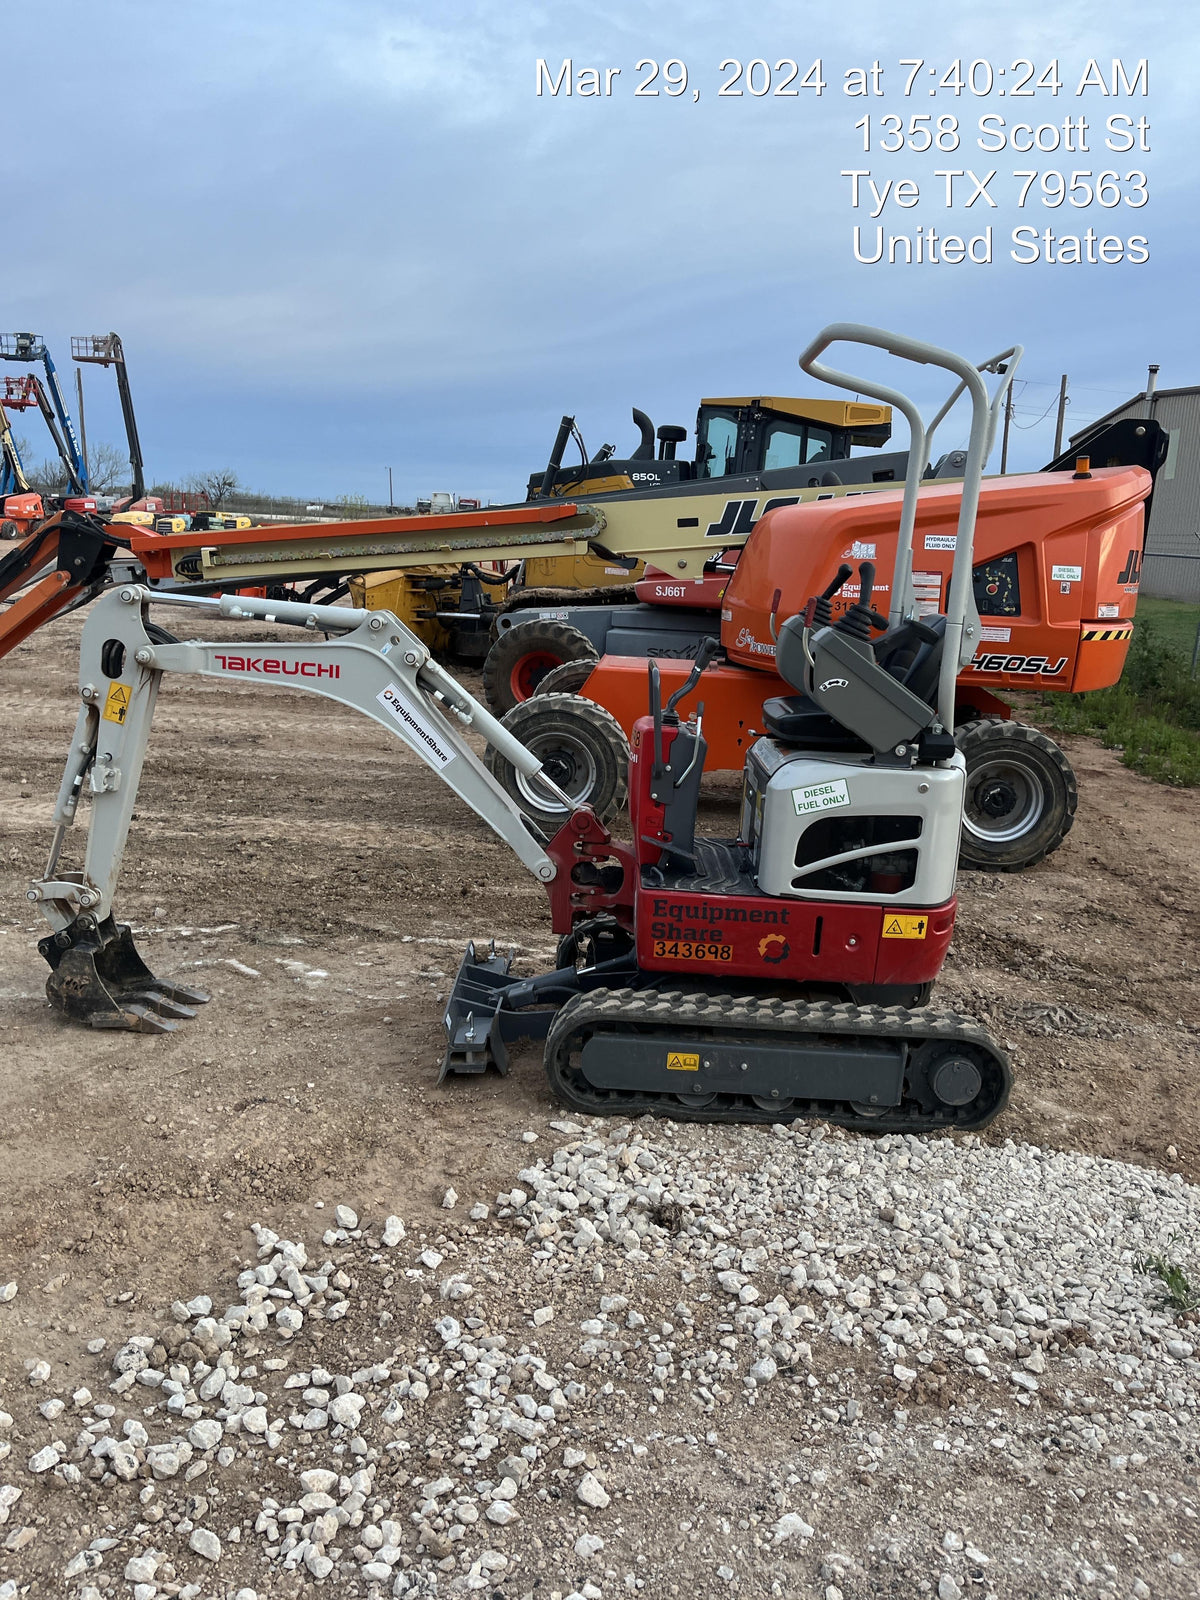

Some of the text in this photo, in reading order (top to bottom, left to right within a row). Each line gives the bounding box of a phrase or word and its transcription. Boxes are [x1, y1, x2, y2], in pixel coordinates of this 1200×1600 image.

[632, 473, 661, 481] 850L
[655, 585, 687, 598] SJ66T
[842, 583, 889, 593] Equient
[214, 654, 340, 679] TAKEUCHI
[970, 653, 1069, 676] 460SJ
[390, 697, 449, 763] EquipmentShare
[803, 785, 836, 799] DIESEL
[797, 794, 846, 812] FUEL ONLY
[652, 898, 791, 925] Equipment
[651, 921, 724, 942] Share
[655, 941, 732, 961] 343698
